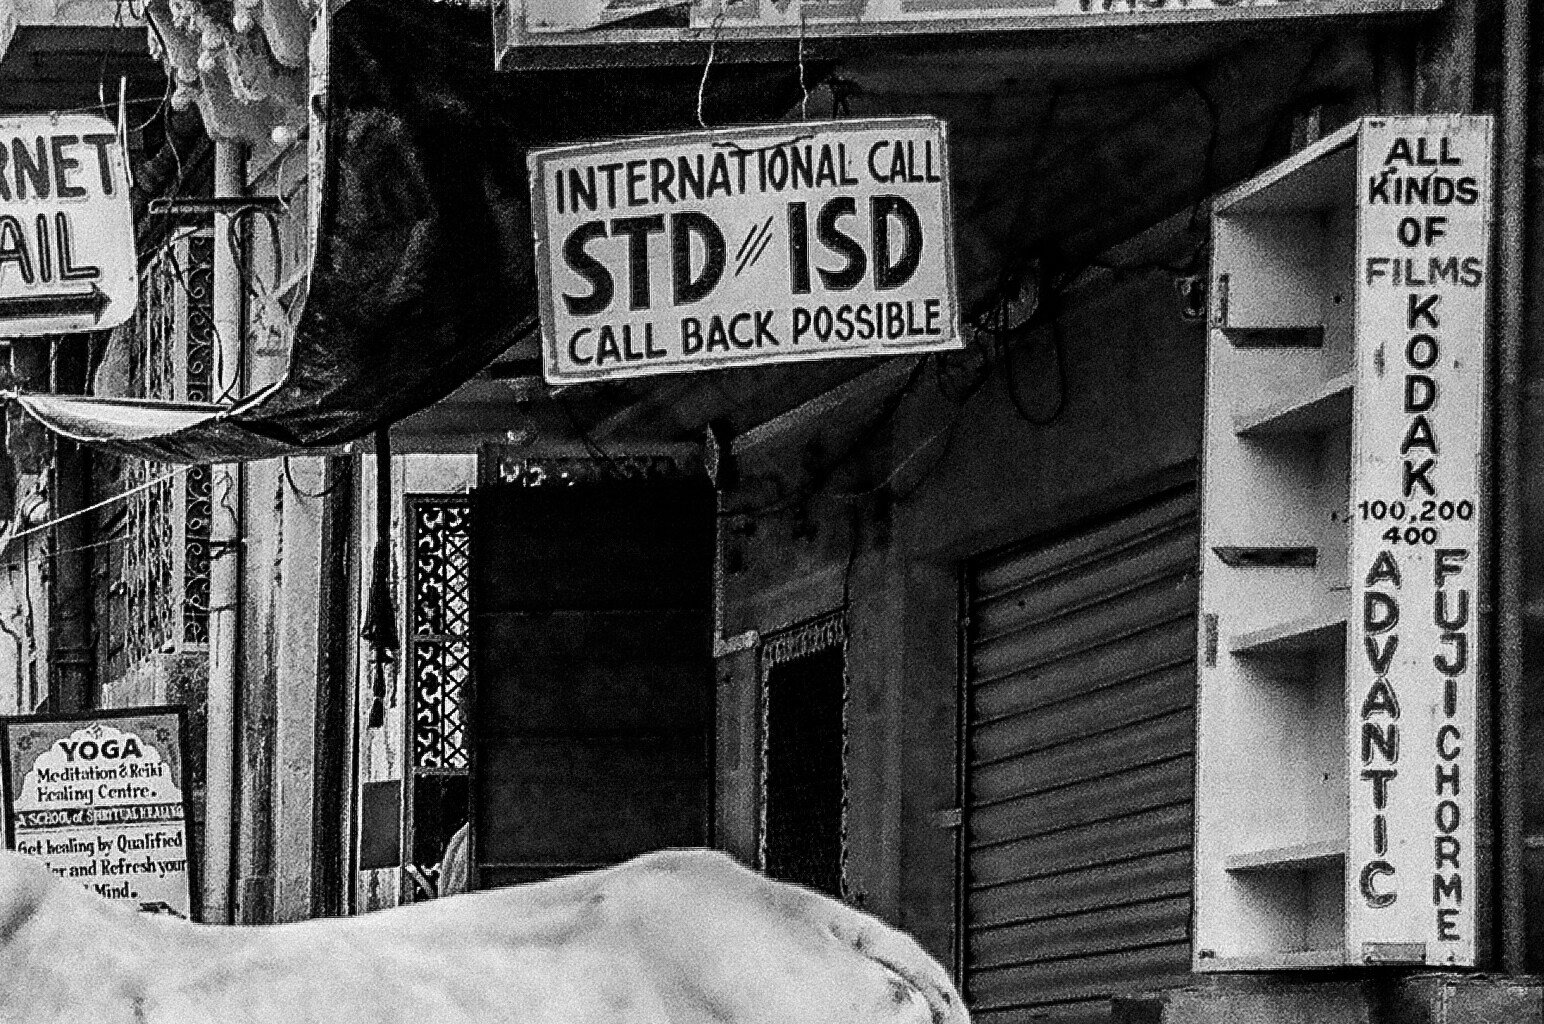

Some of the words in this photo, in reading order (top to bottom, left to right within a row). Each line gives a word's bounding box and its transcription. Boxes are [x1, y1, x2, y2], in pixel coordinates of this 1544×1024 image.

[1385, 137, 1462, 168] ALL
[556, 142, 858, 214] INTERNATIONAL
[868, 140, 942, 185] CALL
[1368, 176, 1480, 206] KINDS
[1396, 216, 1448, 248] OF
[561, 210, 727, 317] STD
[787, 194, 924, 295] ISD
[1366, 256, 1483, 288] FILMS
[568, 322, 668, 366] CALL
[681, 310, 780, 356] BACK
[792, 299, 942, 345] POSSIBLE
[1401, 294, 1440, 498] KODAK
[1382, 526, 1438, 547] 400
[1360, 550, 1402, 909] ADVANTIC
[59, 738, 143, 762] YOGA
[37, 765, 117, 785] Meditation
[130, 761, 165, 779] Reiki
[37, 785, 95, 806] Healing
[17, 839, 43, 856] Get
[46, 837, 95, 858] healing
[97, 835, 114, 857] by
[116, 829, 183, 854] Qualified
[69, 858, 97, 877] and
[100, 855, 157, 877] Refresh
[156, 859, 188, 879] your
